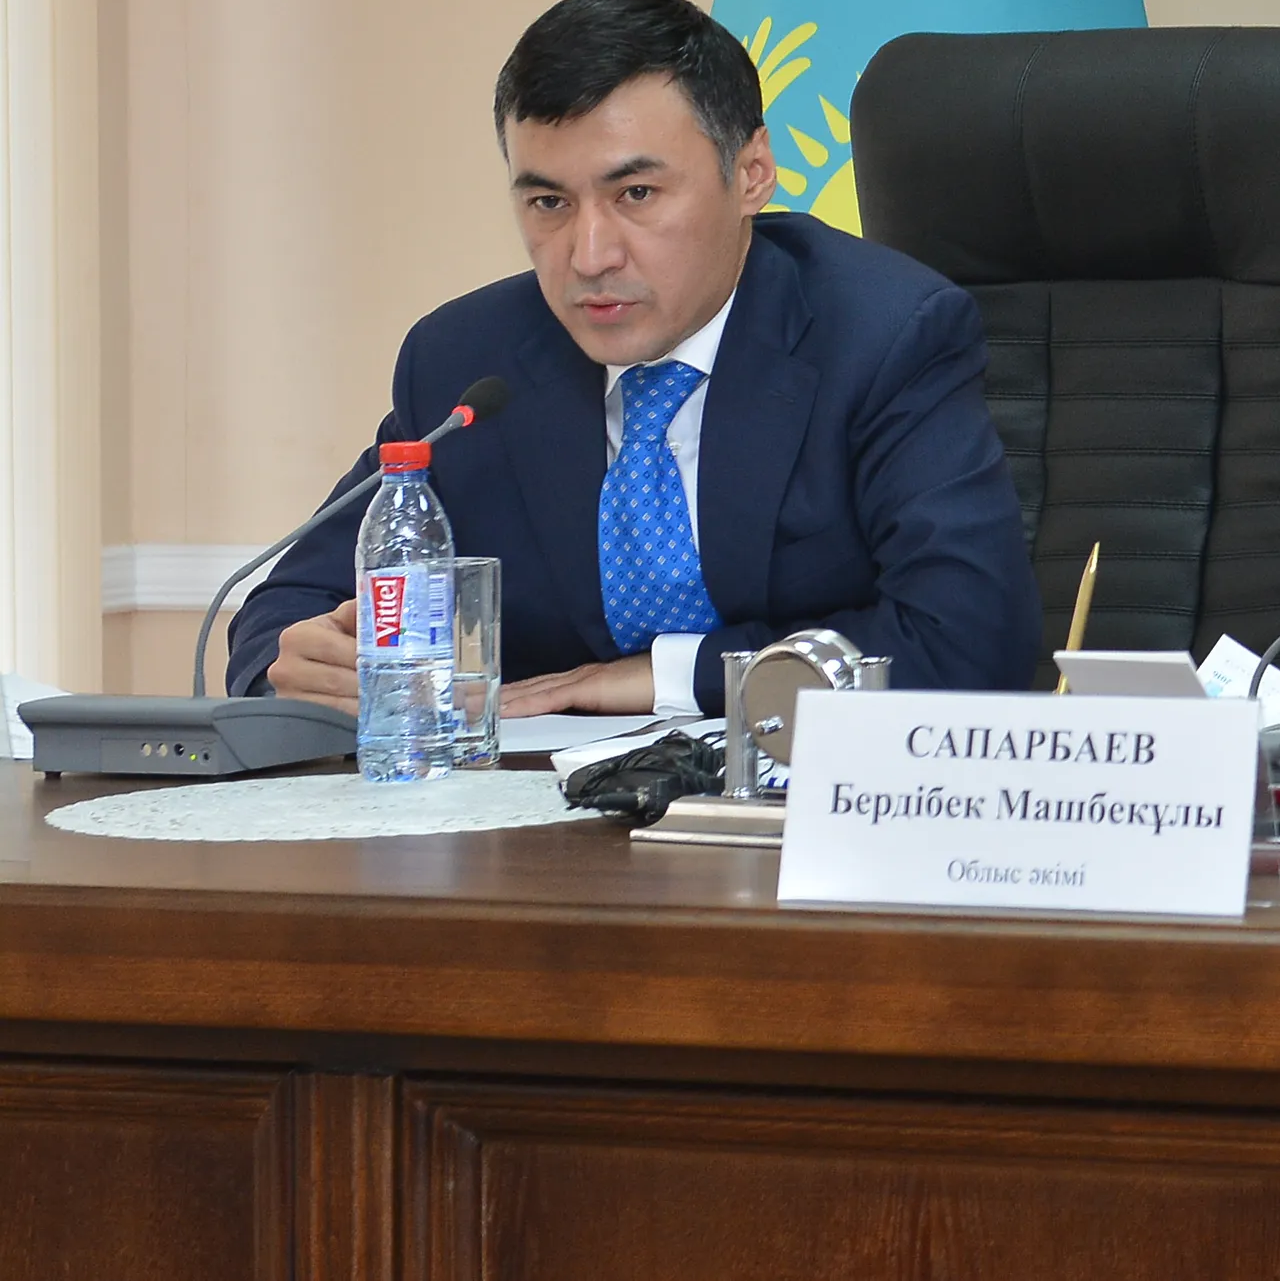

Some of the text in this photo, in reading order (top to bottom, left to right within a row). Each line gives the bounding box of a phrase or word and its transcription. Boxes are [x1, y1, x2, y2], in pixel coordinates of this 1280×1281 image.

[374, 579, 398, 640] Vittel
[906, 724, 1156, 765] САПАРБАЕВ
[829, 782, 1225, 836] Бердібек Машбекұлы
[947, 858, 1086, 887] Облыс әкімі
